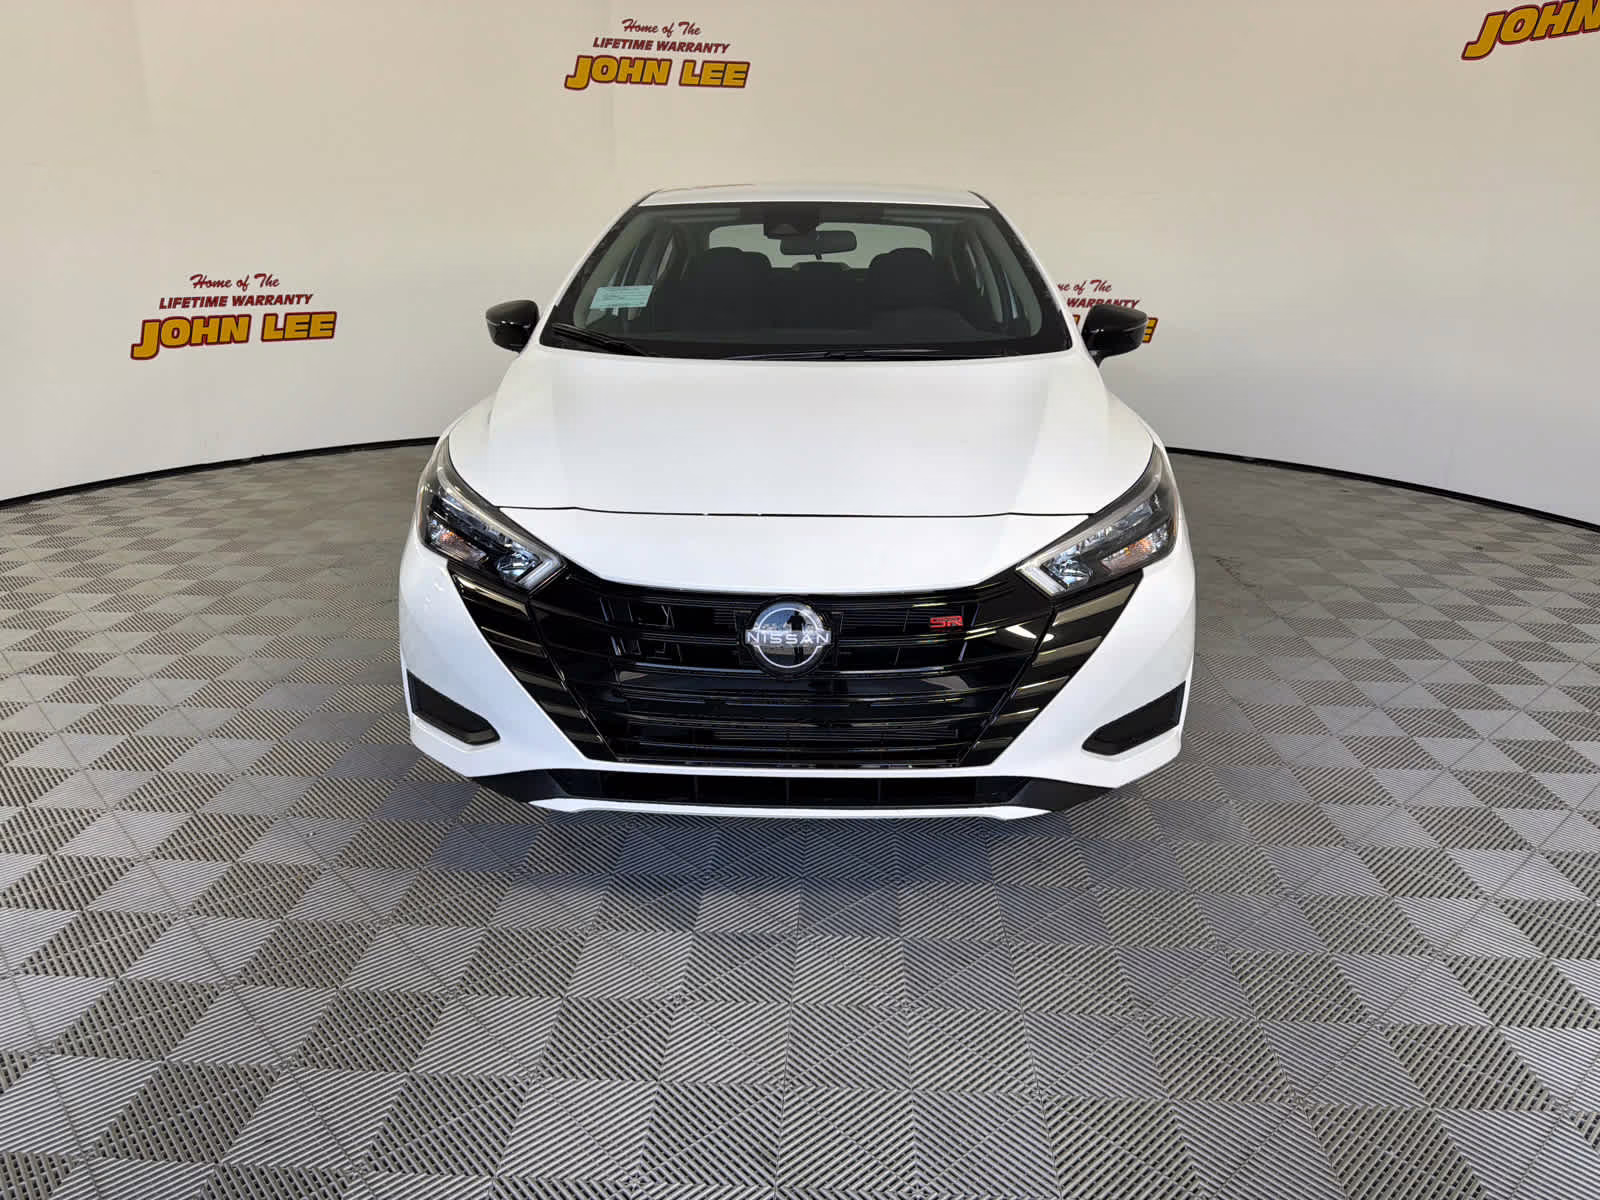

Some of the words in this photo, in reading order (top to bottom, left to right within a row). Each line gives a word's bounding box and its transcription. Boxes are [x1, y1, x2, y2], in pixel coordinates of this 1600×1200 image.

[621, 18, 659, 34] Home
[662, 22, 674, 38] of
[678, 21, 701, 36] The
[593, 37, 653, 51] LIFETIME
[656, 40, 730, 54] WARRANTY
[564, 54, 672, 91] JOHN
[679, 59, 750, 88] LEE
[190, 273, 233, 289] Home
[236, 274, 250, 292] of
[254, 273, 280, 288] The
[1073, 280, 1086, 295] of
[1090, 279, 1112, 293] The
[159, 295, 229, 310] LIFETIME
[231, 293, 314, 307] WARRANTY
[130, 313, 252, 360] JOHN
[261, 311, 337, 342] LEE
[929, 615, 963, 630] SR
[747, 632, 830, 645] NISSAN
